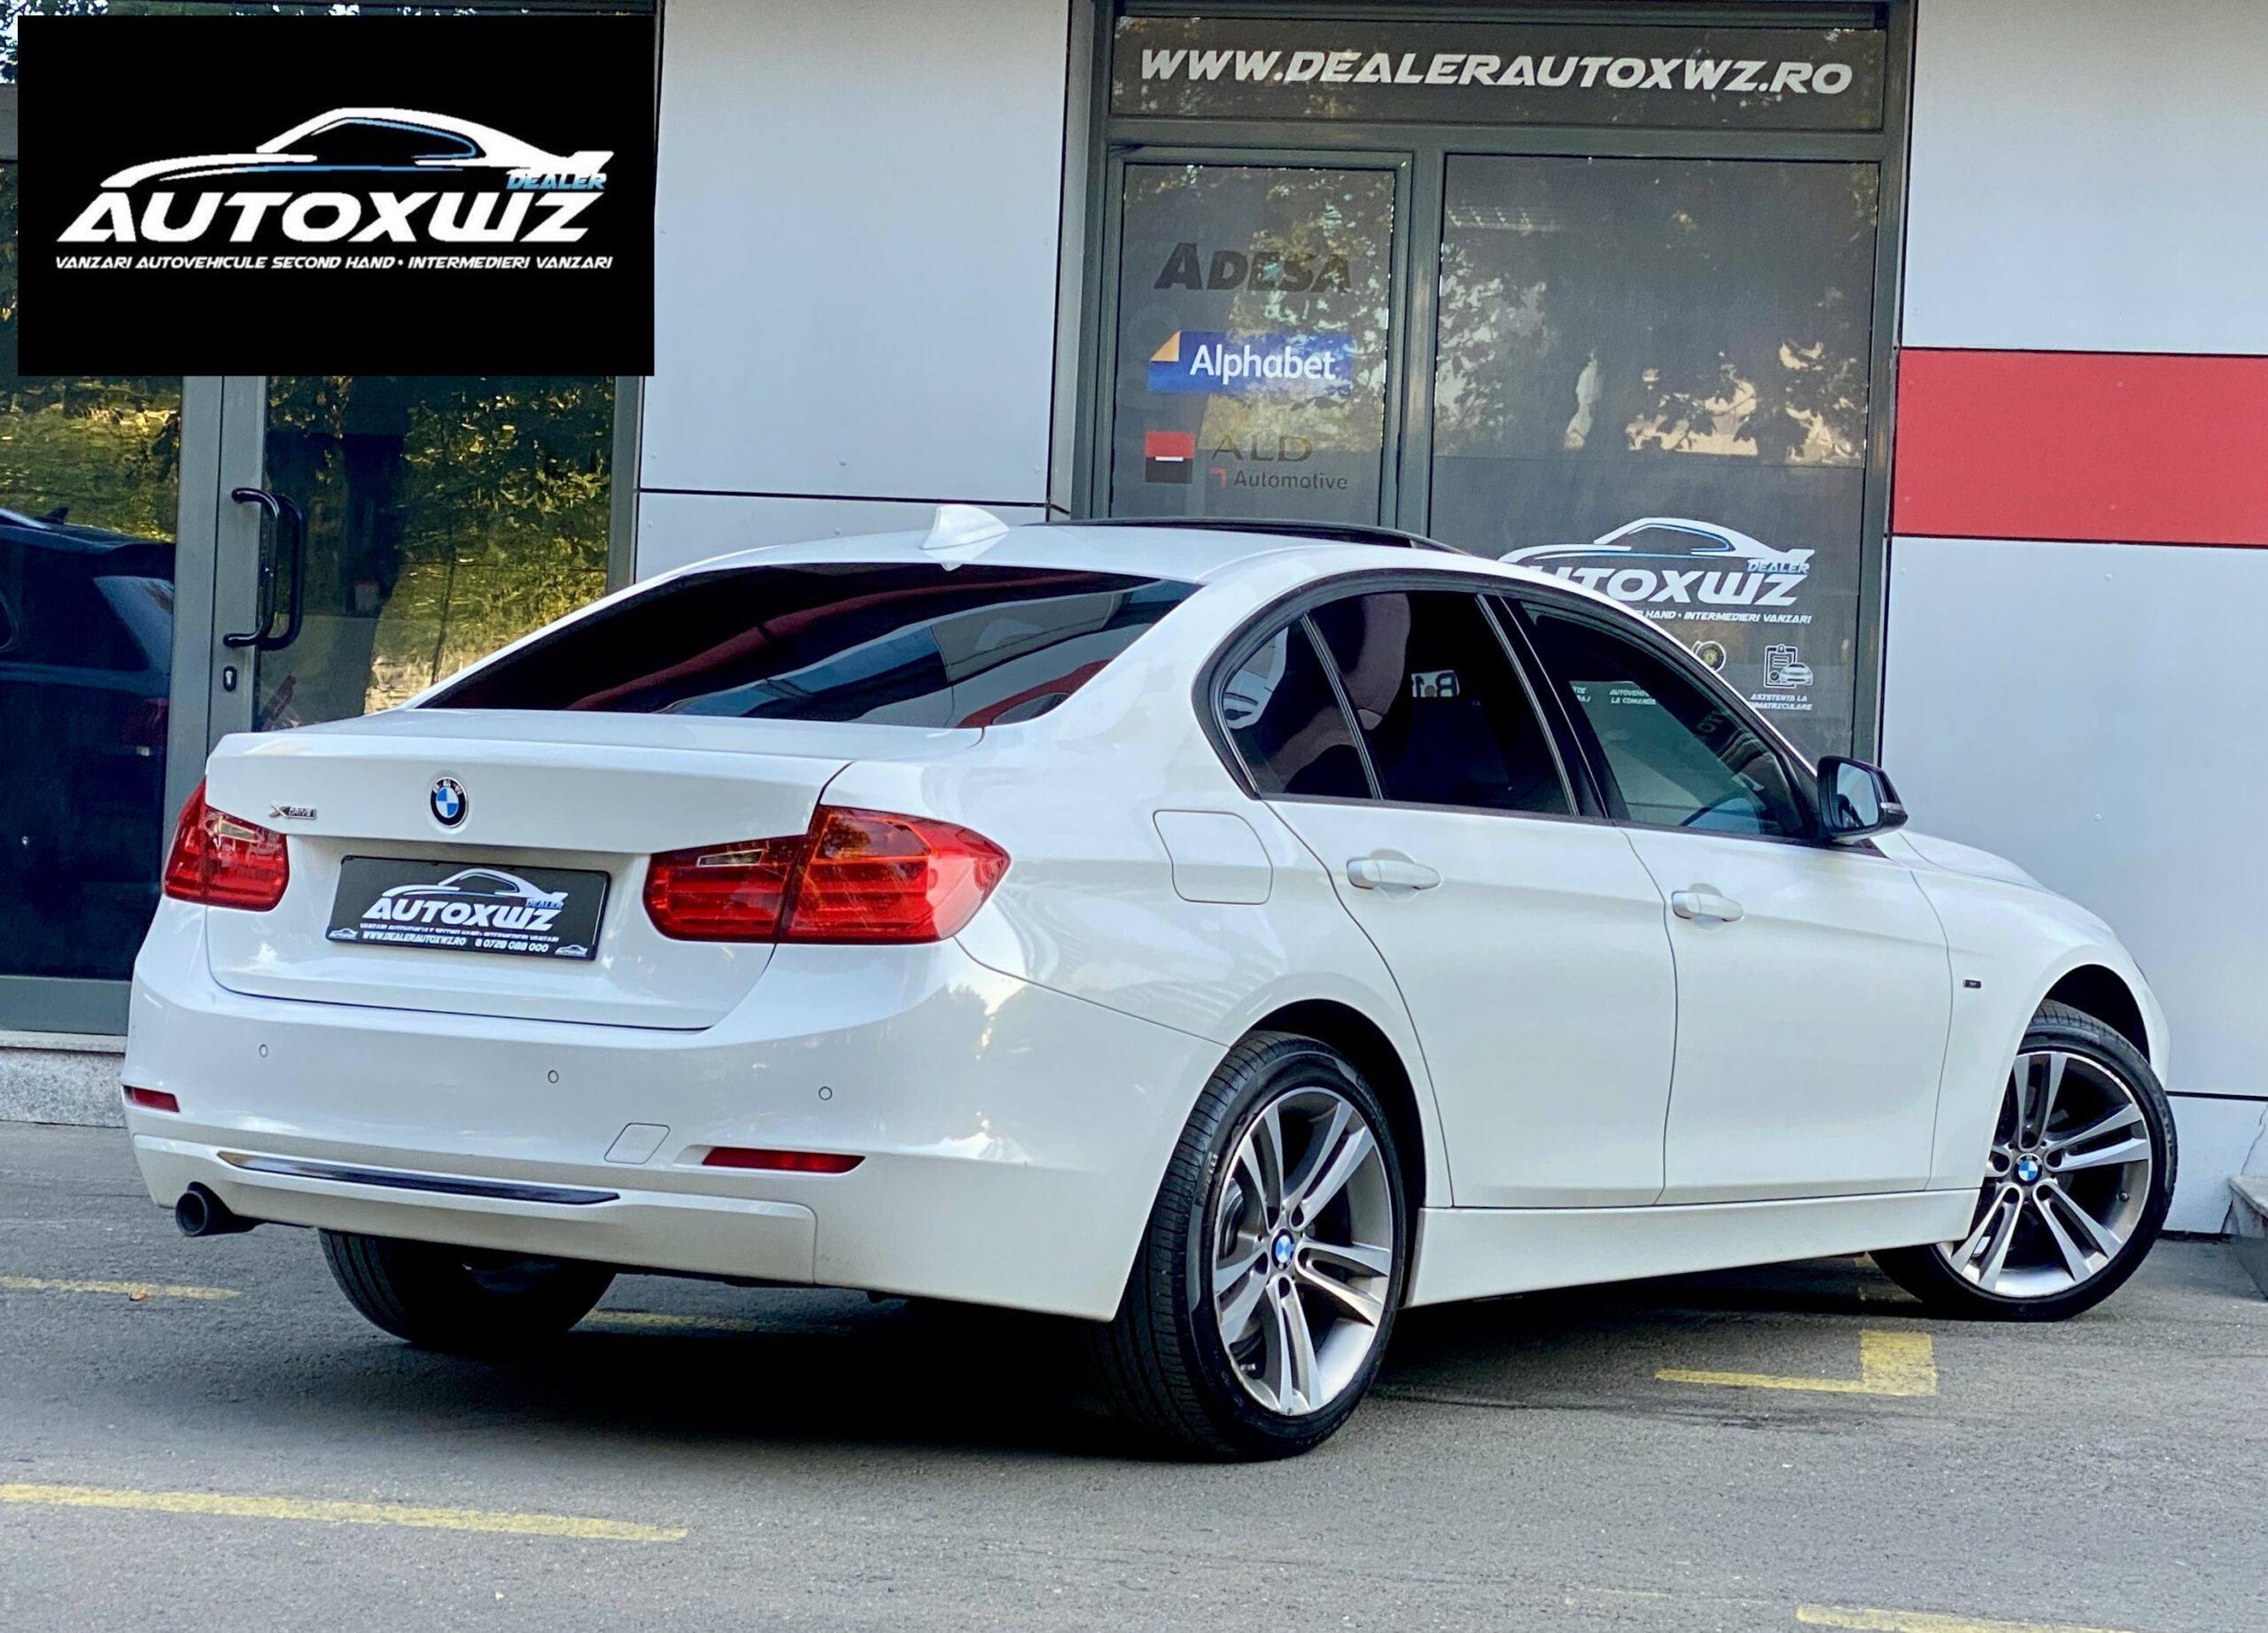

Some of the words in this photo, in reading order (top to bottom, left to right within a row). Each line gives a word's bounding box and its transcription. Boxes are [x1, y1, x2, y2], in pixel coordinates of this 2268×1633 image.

[1140, 48, 1854, 95] WWW.DEALERAUTOXWZ.RO
[1153, 243, 1352, 293] ADESA
[1189, 344, 1336, 385] Alphabet
[1211, 435, 1313, 462] ALD
[1233, 470, 1348, 490] Automotive
[1747, 560, 1810, 574] DEALER
[1645, 610, 1677, 619] HAND
[1683, 610, 1761, 622] INTERMEDIERI
[1763, 613, 1813, 625] VANZARI
[361, 898, 563, 931] AUTOXWZ
